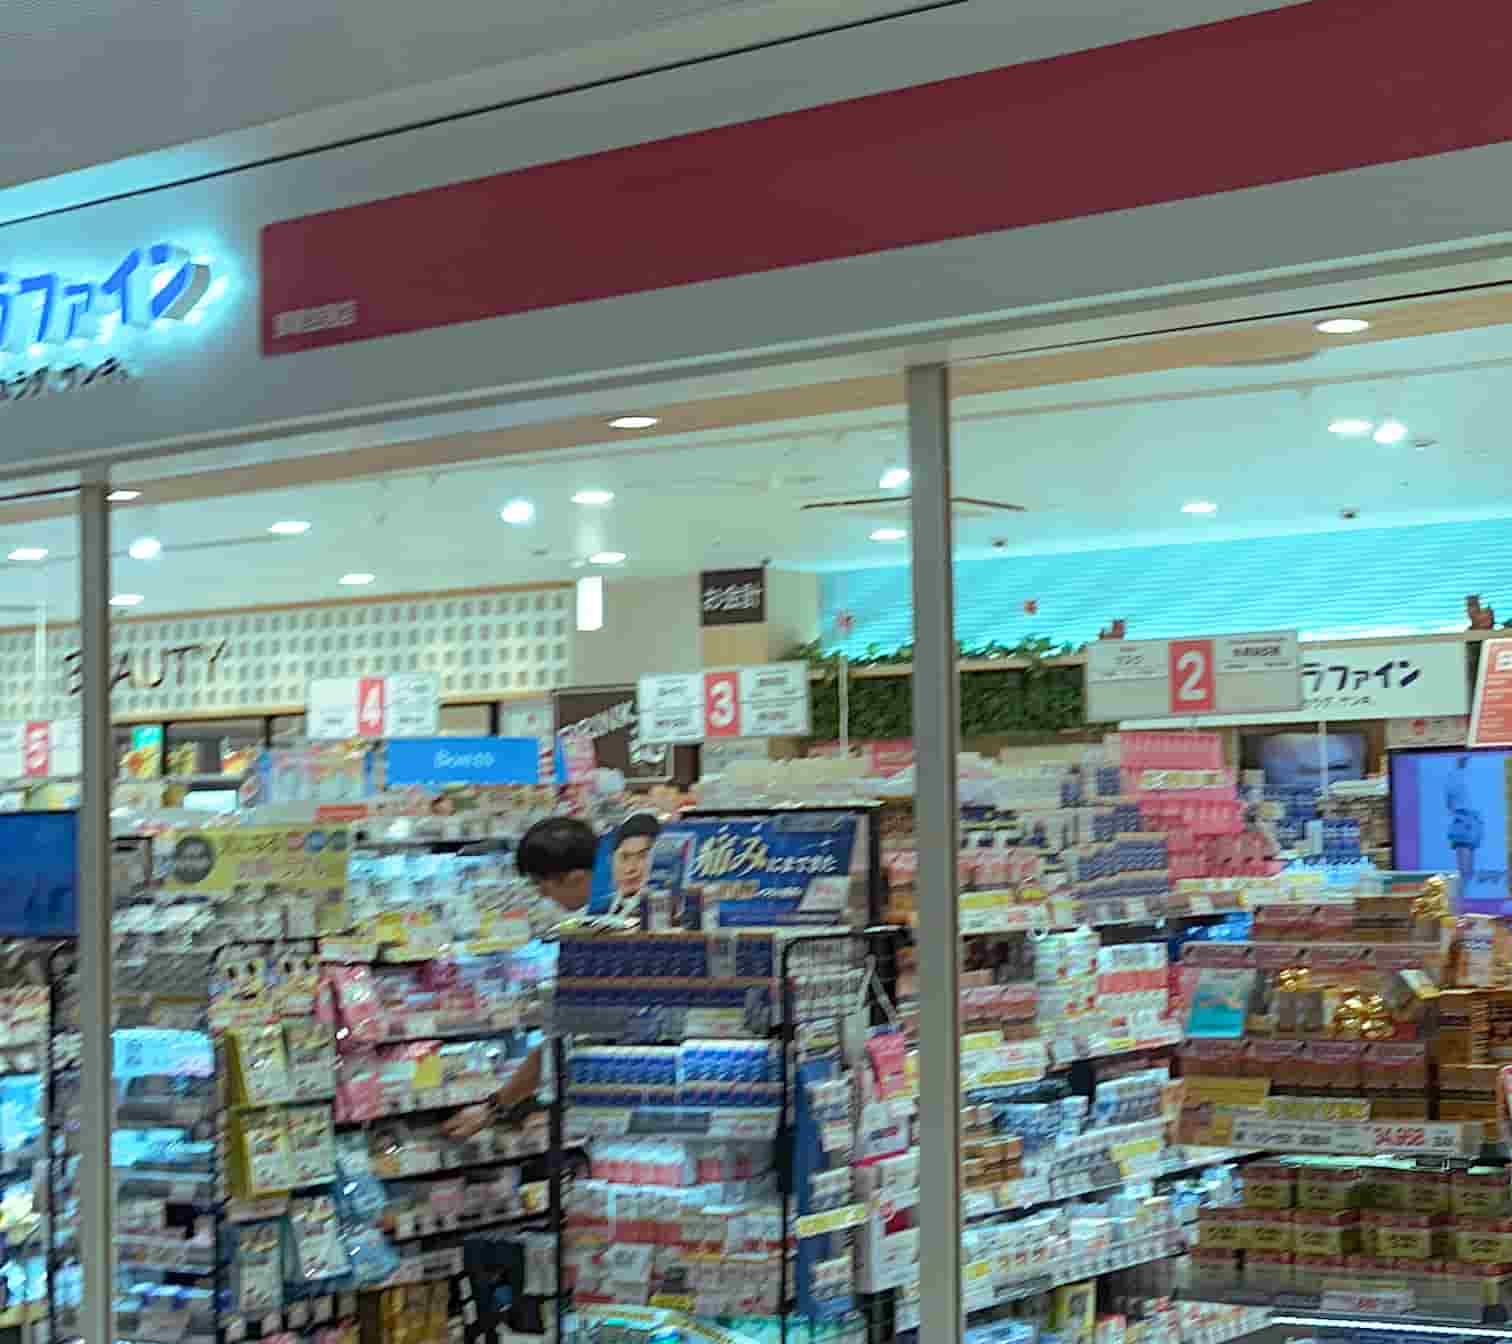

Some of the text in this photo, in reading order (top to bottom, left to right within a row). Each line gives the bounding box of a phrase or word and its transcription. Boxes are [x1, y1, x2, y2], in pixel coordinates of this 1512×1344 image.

[1177, 650, 1208, 701] 2
[360, 686, 383, 727] 4
[709, 680, 735, 727] 3
